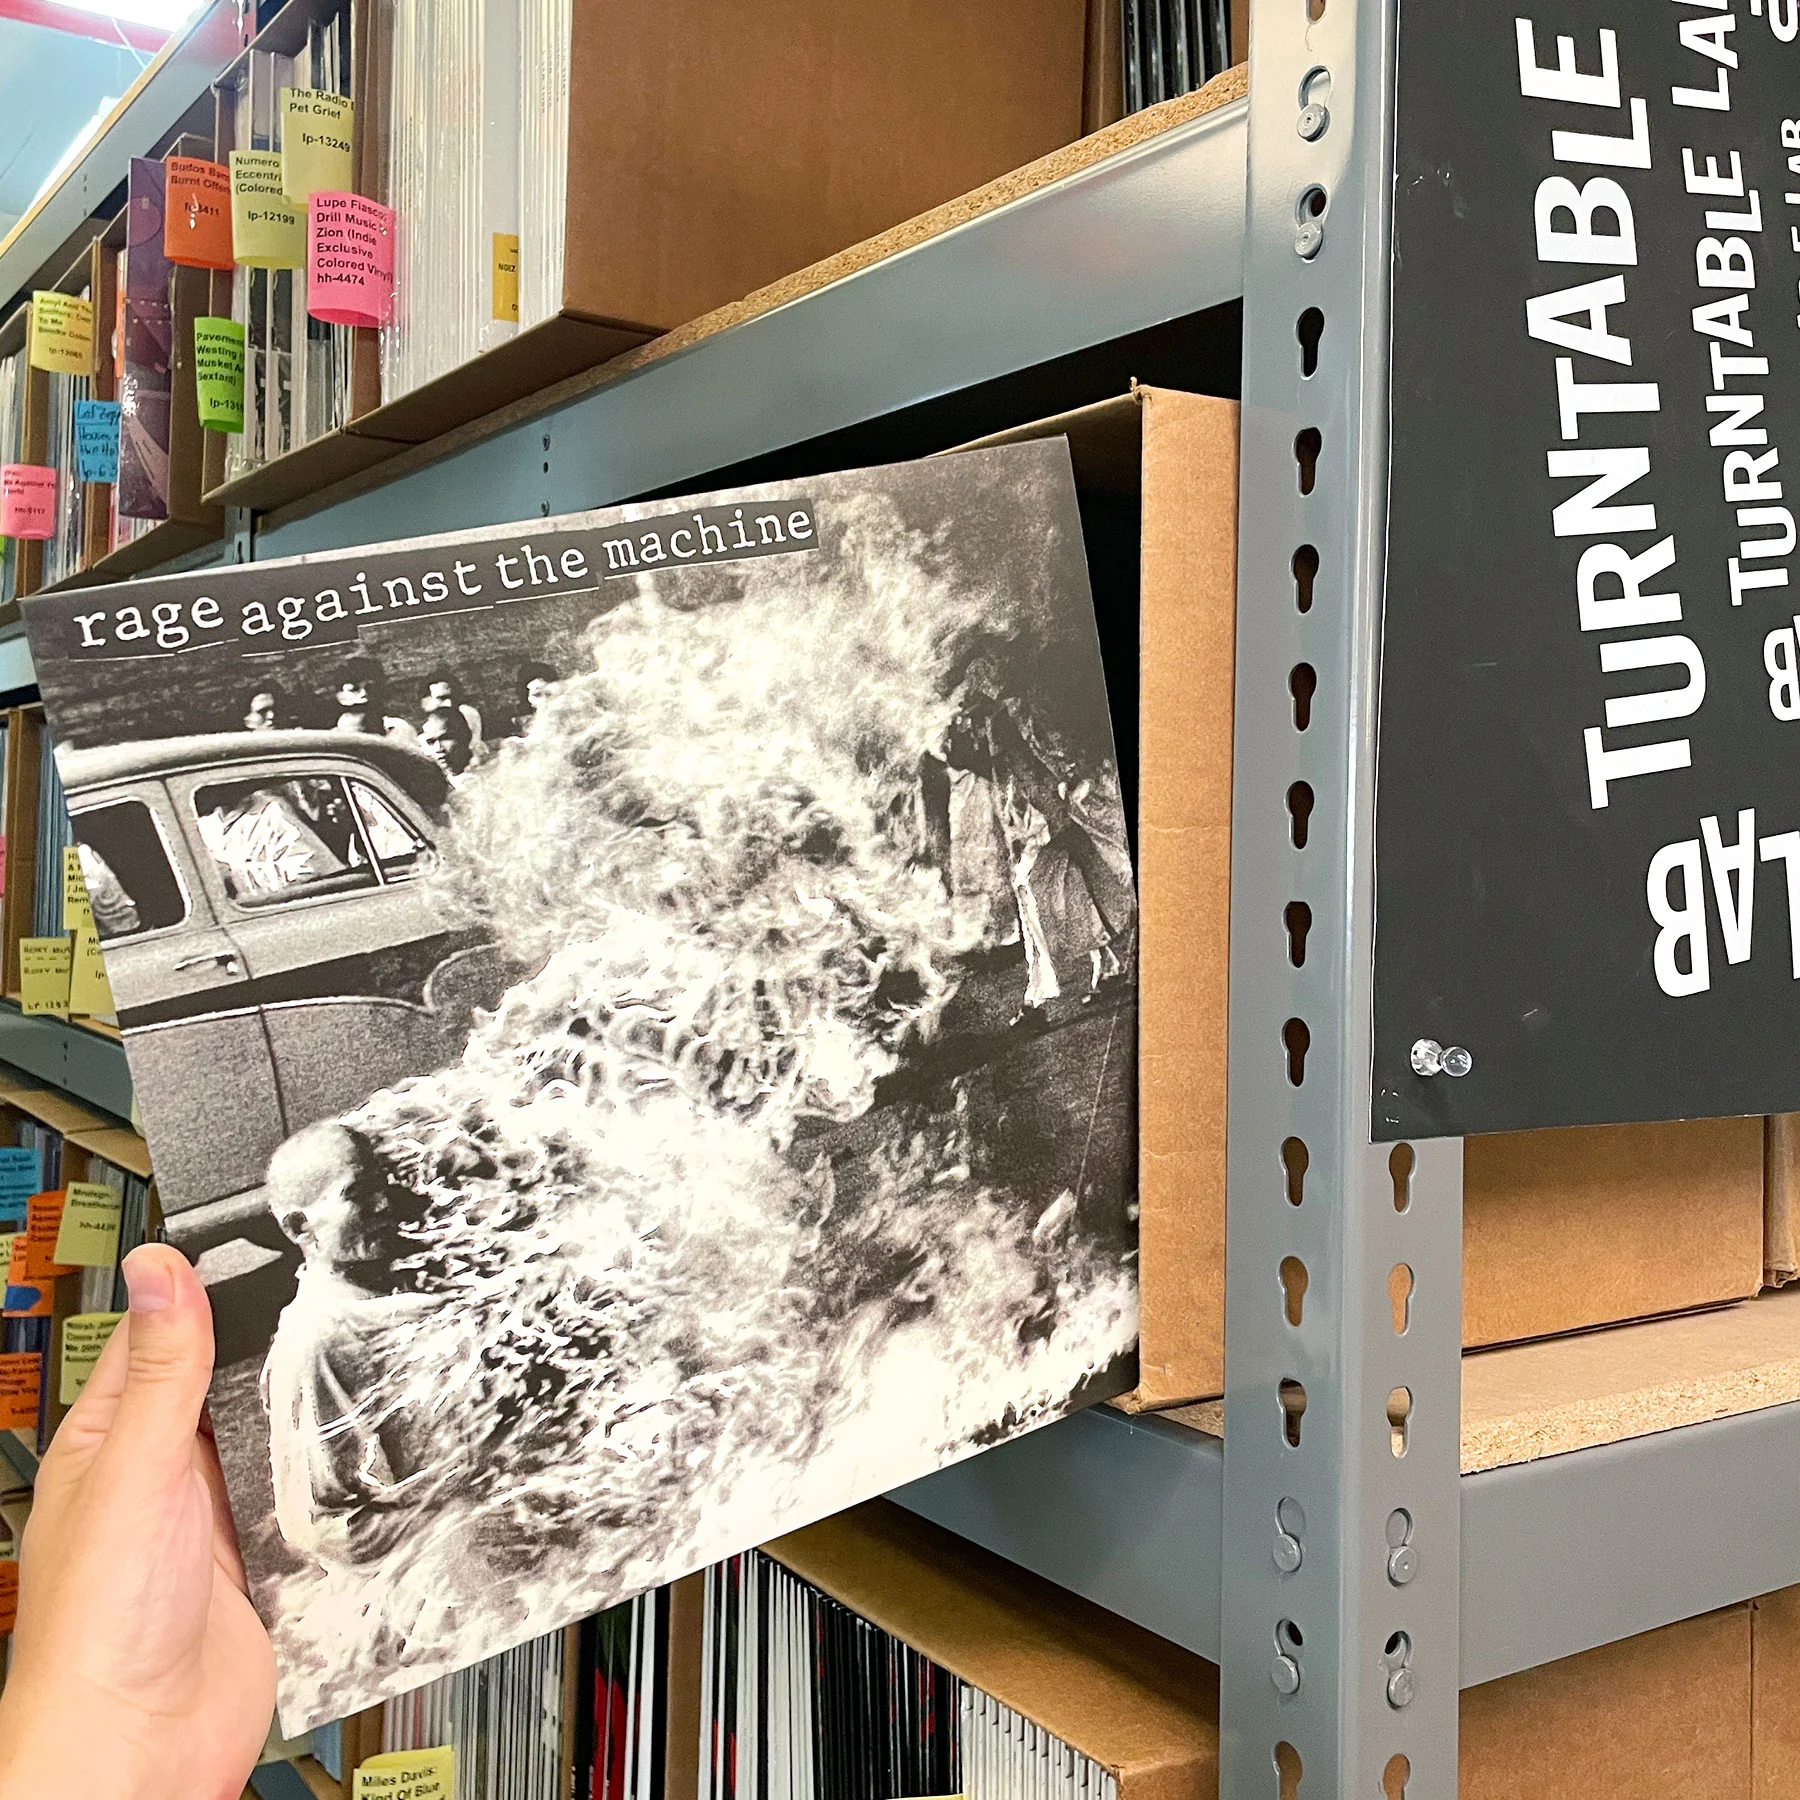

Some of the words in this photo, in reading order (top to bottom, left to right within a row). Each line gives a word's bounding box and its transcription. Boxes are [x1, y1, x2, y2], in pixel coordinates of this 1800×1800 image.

[1672, 0, 1738, 110] LA
[290, 87, 312, 99] The
[316, 90, 348, 108] Radio
[289, 102, 309, 113] Pet
[312, 104, 341, 120] Grief
[302, 133, 351, 153] lp-13249
[235, 156, 280, 168] Numero
[170, 175, 201, 186] Burnt
[235, 183, 283, 195] (Colored
[316, 197, 347, 209] Lupe
[247, 210, 295, 225] lp-12199
[316, 212, 342, 223] Drill
[344, 213, 378, 231] Music
[316, 227, 344, 238] Zion
[347, 228, 377, 246] (Indie
[316, 242, 374, 259] Exclusive
[316, 257, 365, 271] Colored
[316, 272, 365, 286] hh-4474
[196, 358, 233, 371] Musket
[1682, 148, 1796, 606] TURNTABLE
[1516, 18, 1705, 809] TURNTABLE
[73, 596, 225, 649] rage
[240, 559, 483, 641] against
[495, 544, 589, 591] the
[602, 508, 814, 571] machine
[361, 1775, 397, 1787] Miles
[396, 1786, 413, 1800] Of
[414, 1782, 440, 1798] Blue
